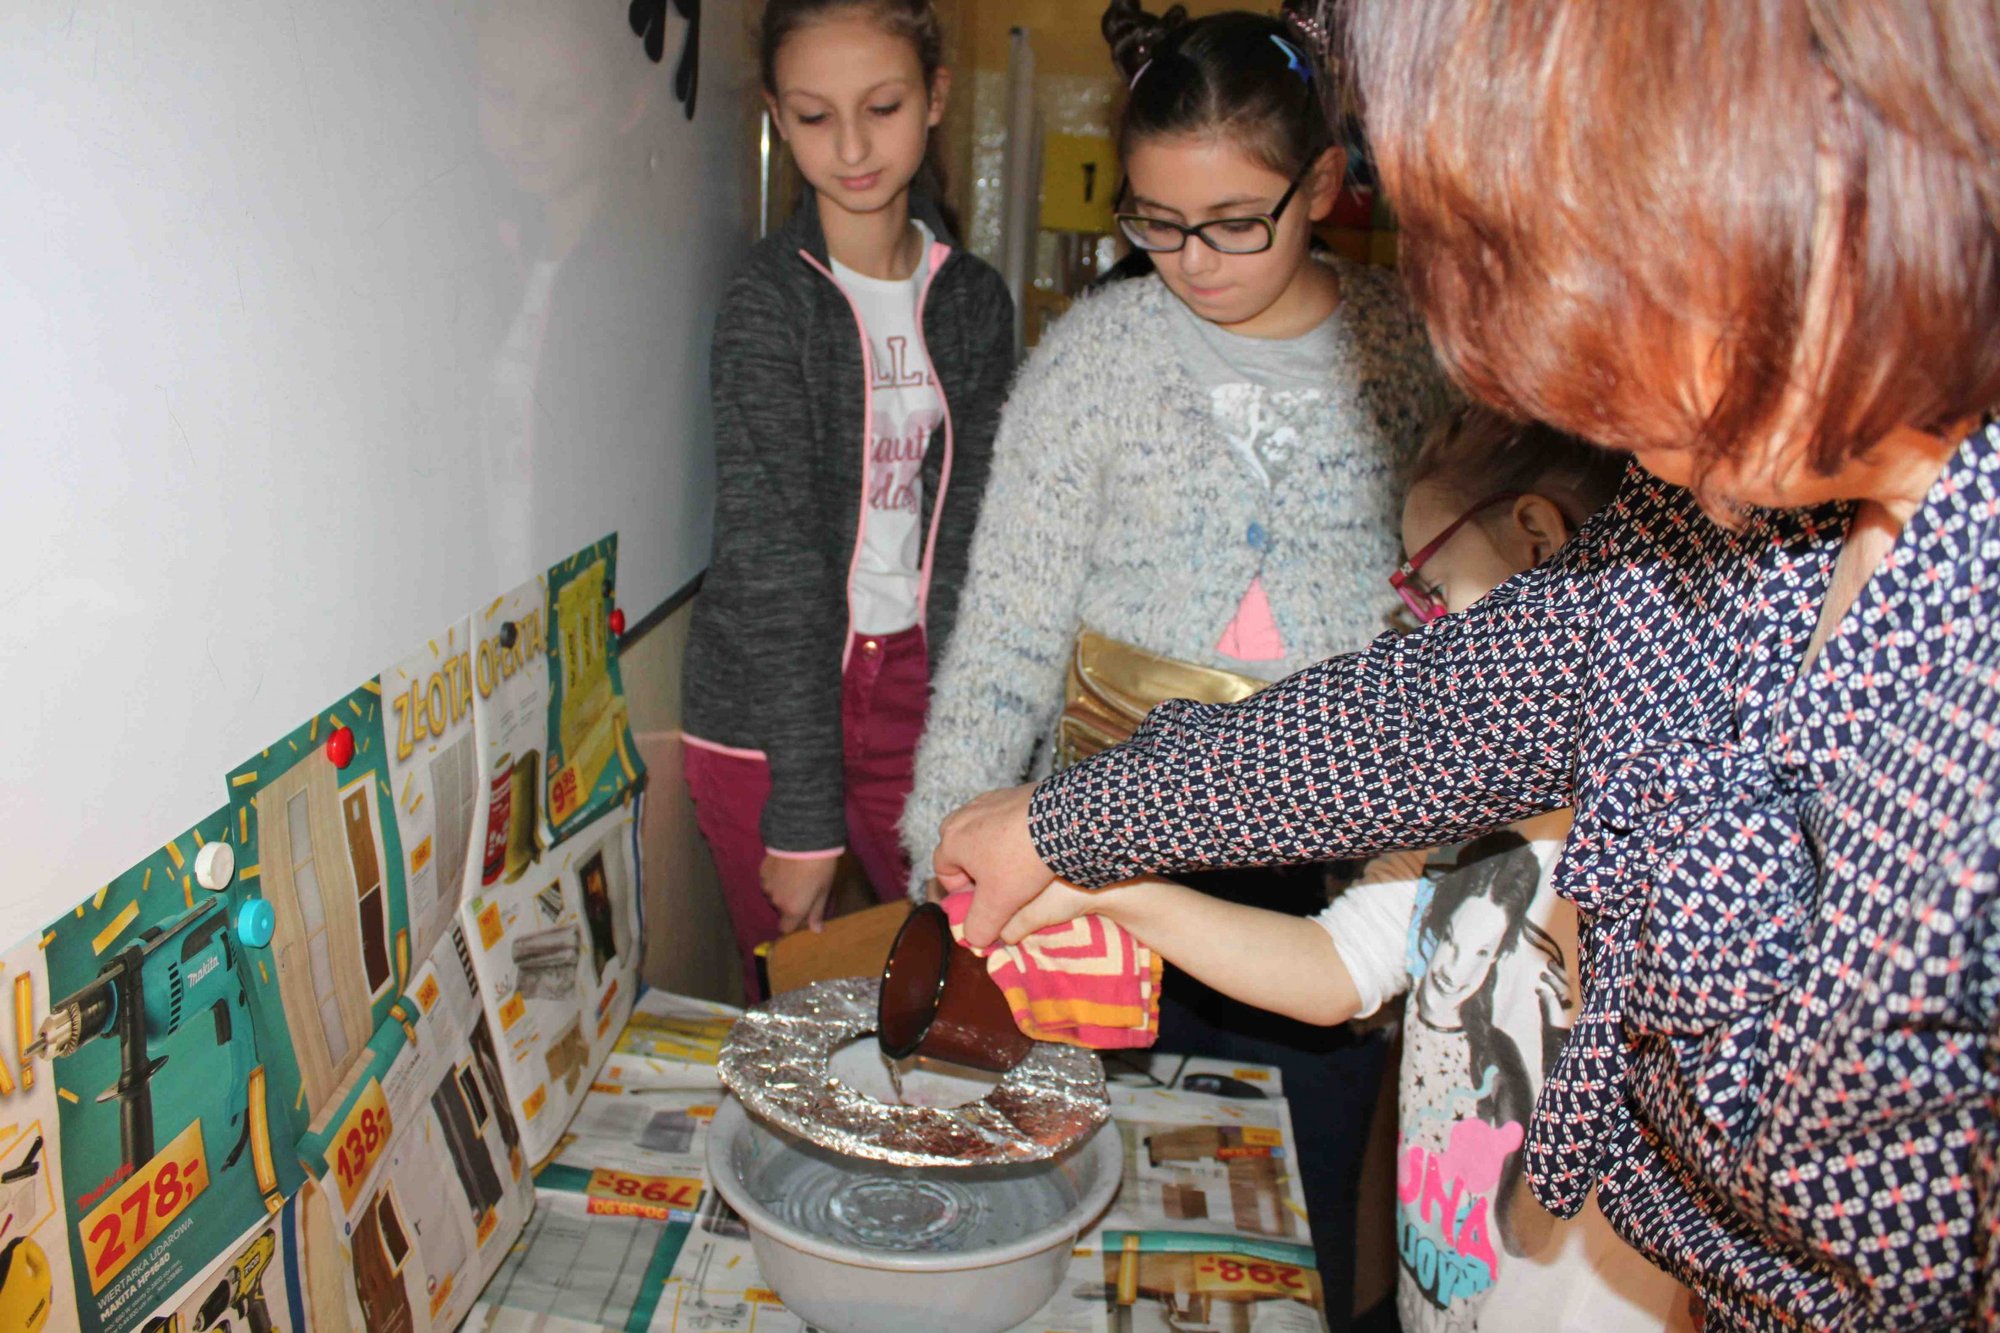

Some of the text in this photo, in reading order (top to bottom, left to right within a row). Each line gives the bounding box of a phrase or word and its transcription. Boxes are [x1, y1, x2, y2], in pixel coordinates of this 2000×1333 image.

[98, 1217, 194, 1310] WIERTARKA UDAROWA
[100, 1284, 138, 1323] MAKITA
[137, 1252, 171, 1289] HP1640
